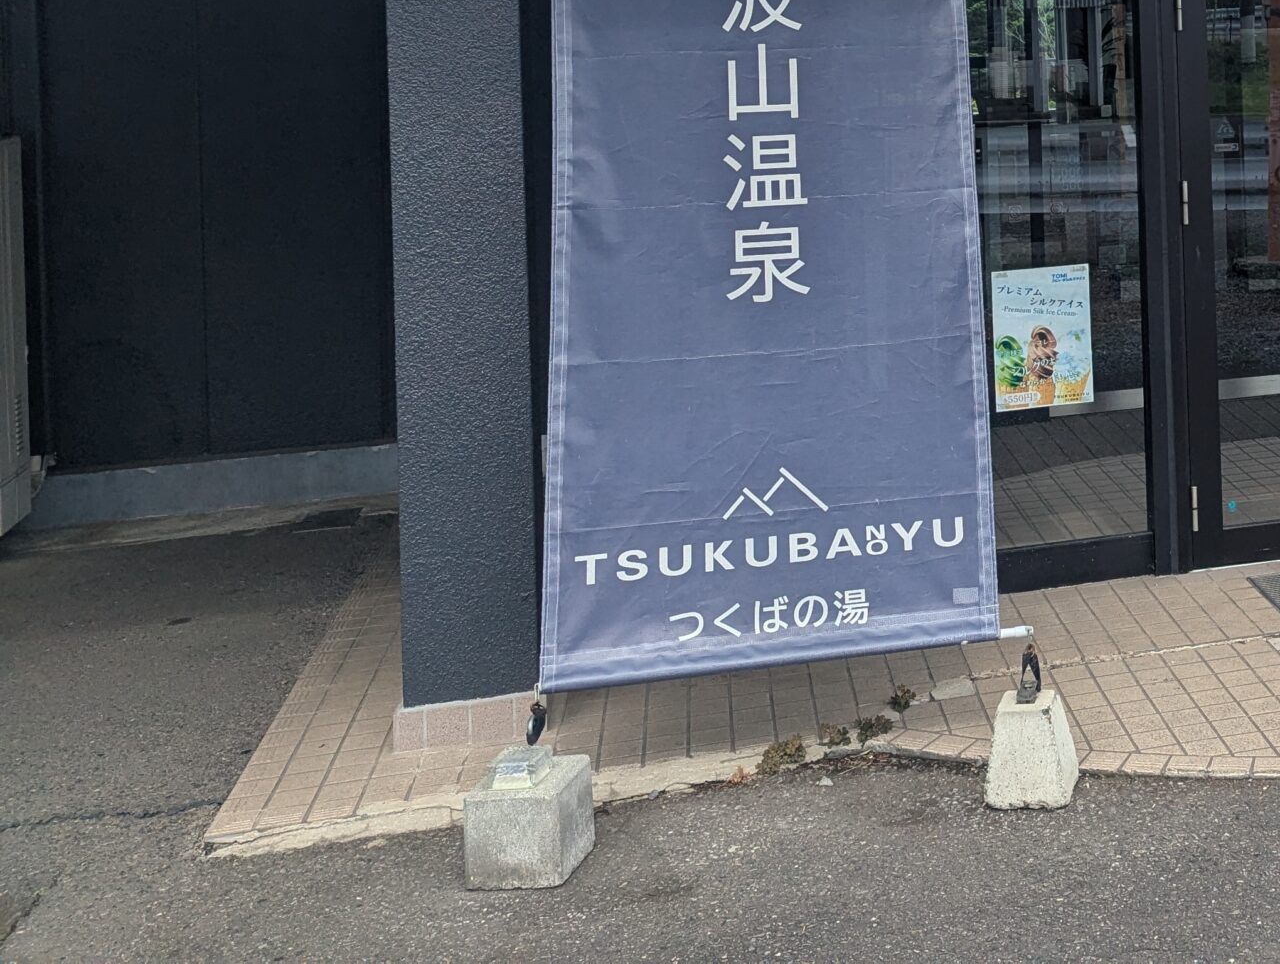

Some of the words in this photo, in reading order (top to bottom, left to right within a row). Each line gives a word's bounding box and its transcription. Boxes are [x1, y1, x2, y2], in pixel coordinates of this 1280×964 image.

[997, 285, 1042, 296] プレミアム
[1030, 298, 1084, 308] シルクアイス
[669, 588, 870, 642] つくばの湯
